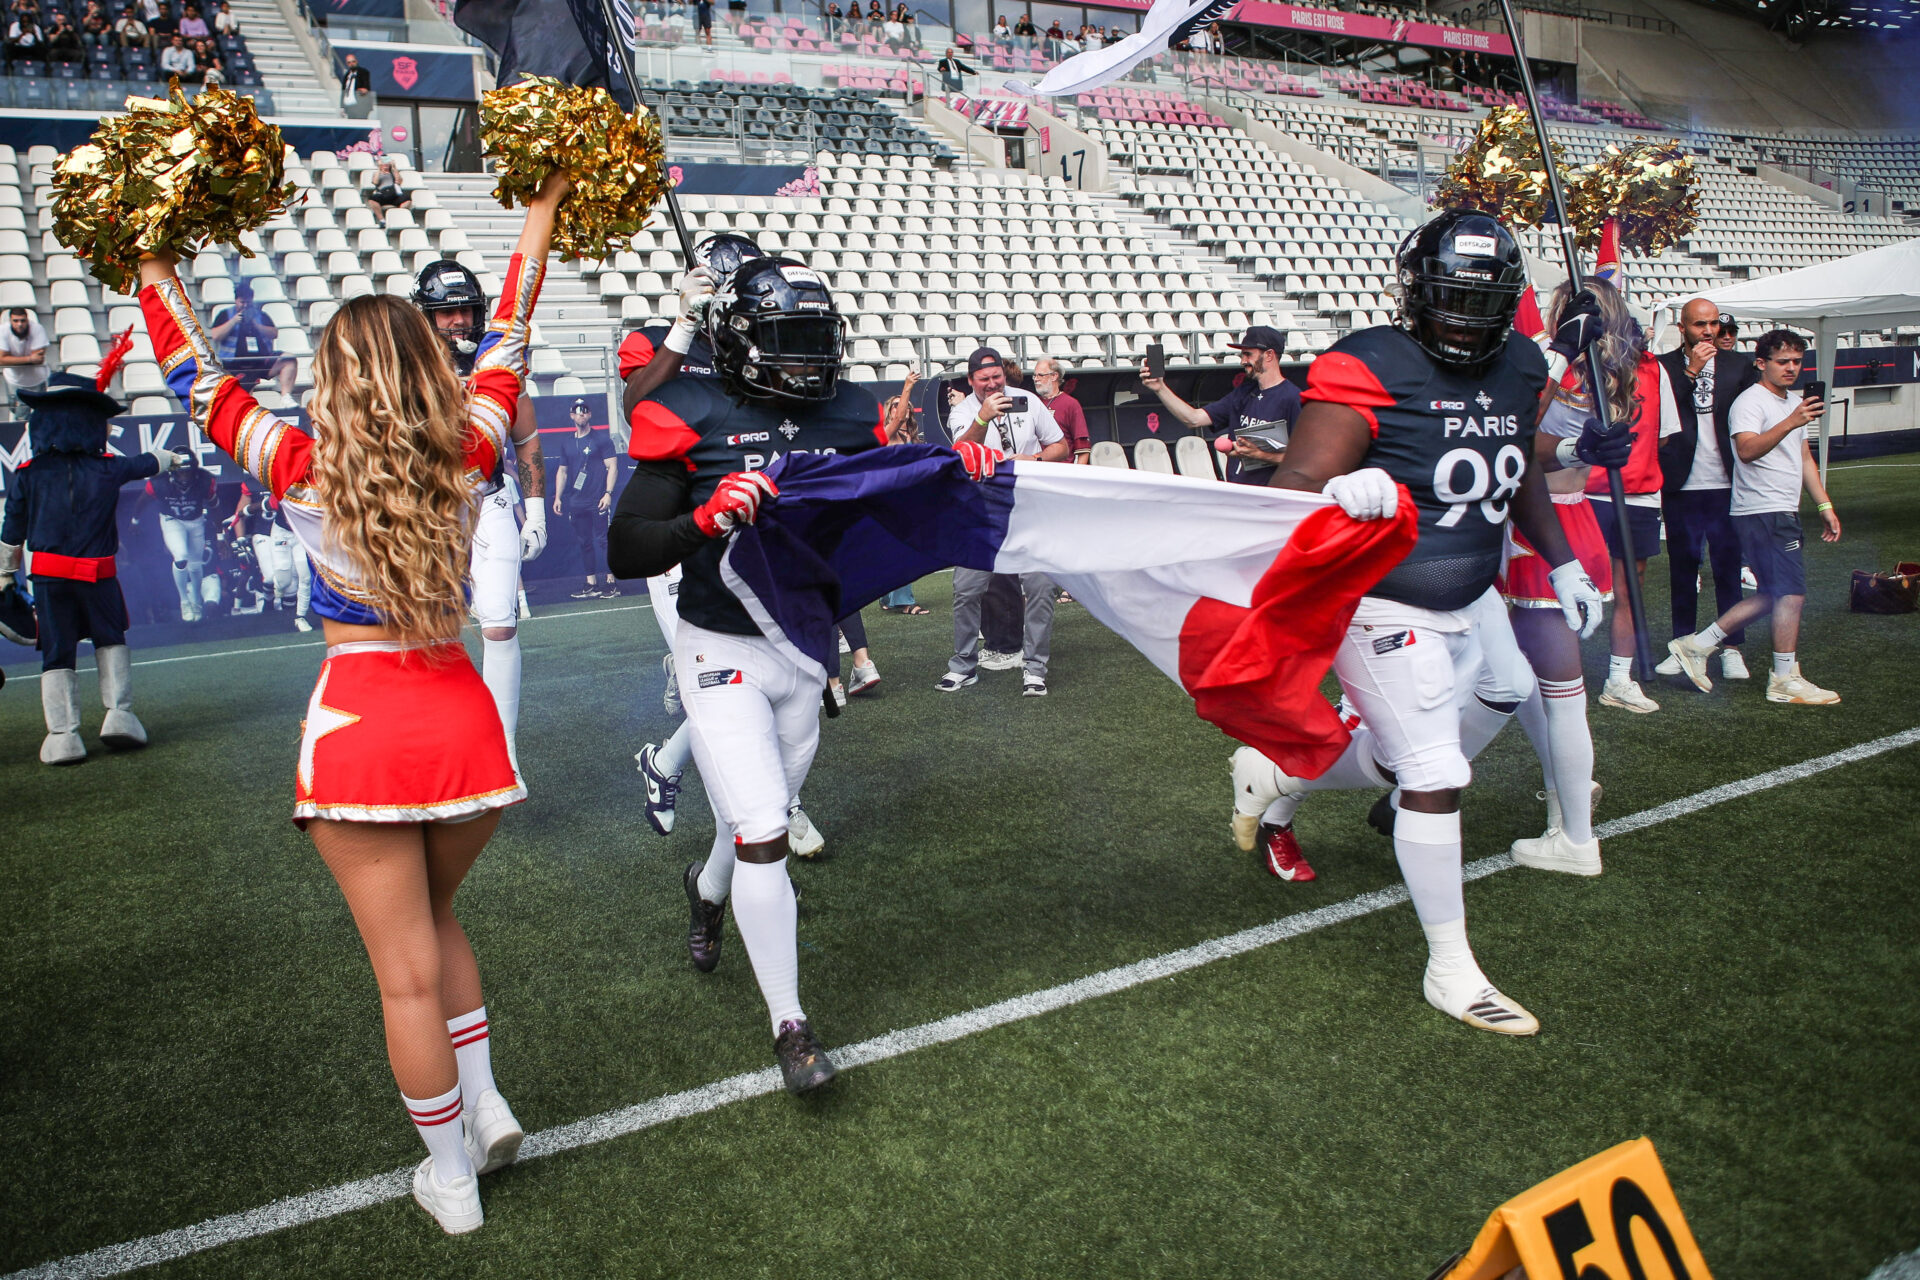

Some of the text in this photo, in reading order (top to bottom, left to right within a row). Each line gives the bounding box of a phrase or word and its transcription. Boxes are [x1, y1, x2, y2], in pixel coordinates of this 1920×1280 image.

[1291, 10, 1345, 30] PARIS EST ROSE
[1443, 30, 1489, 49] PARIS EST ROSE
[1060, 149, 1085, 190] 17
[1843, 199, 1869, 213] 21
[1444, 415, 1518, 438] PARIS
[1433, 444, 1526, 527] 98
[1542, 1175, 1693, 1280] 50
